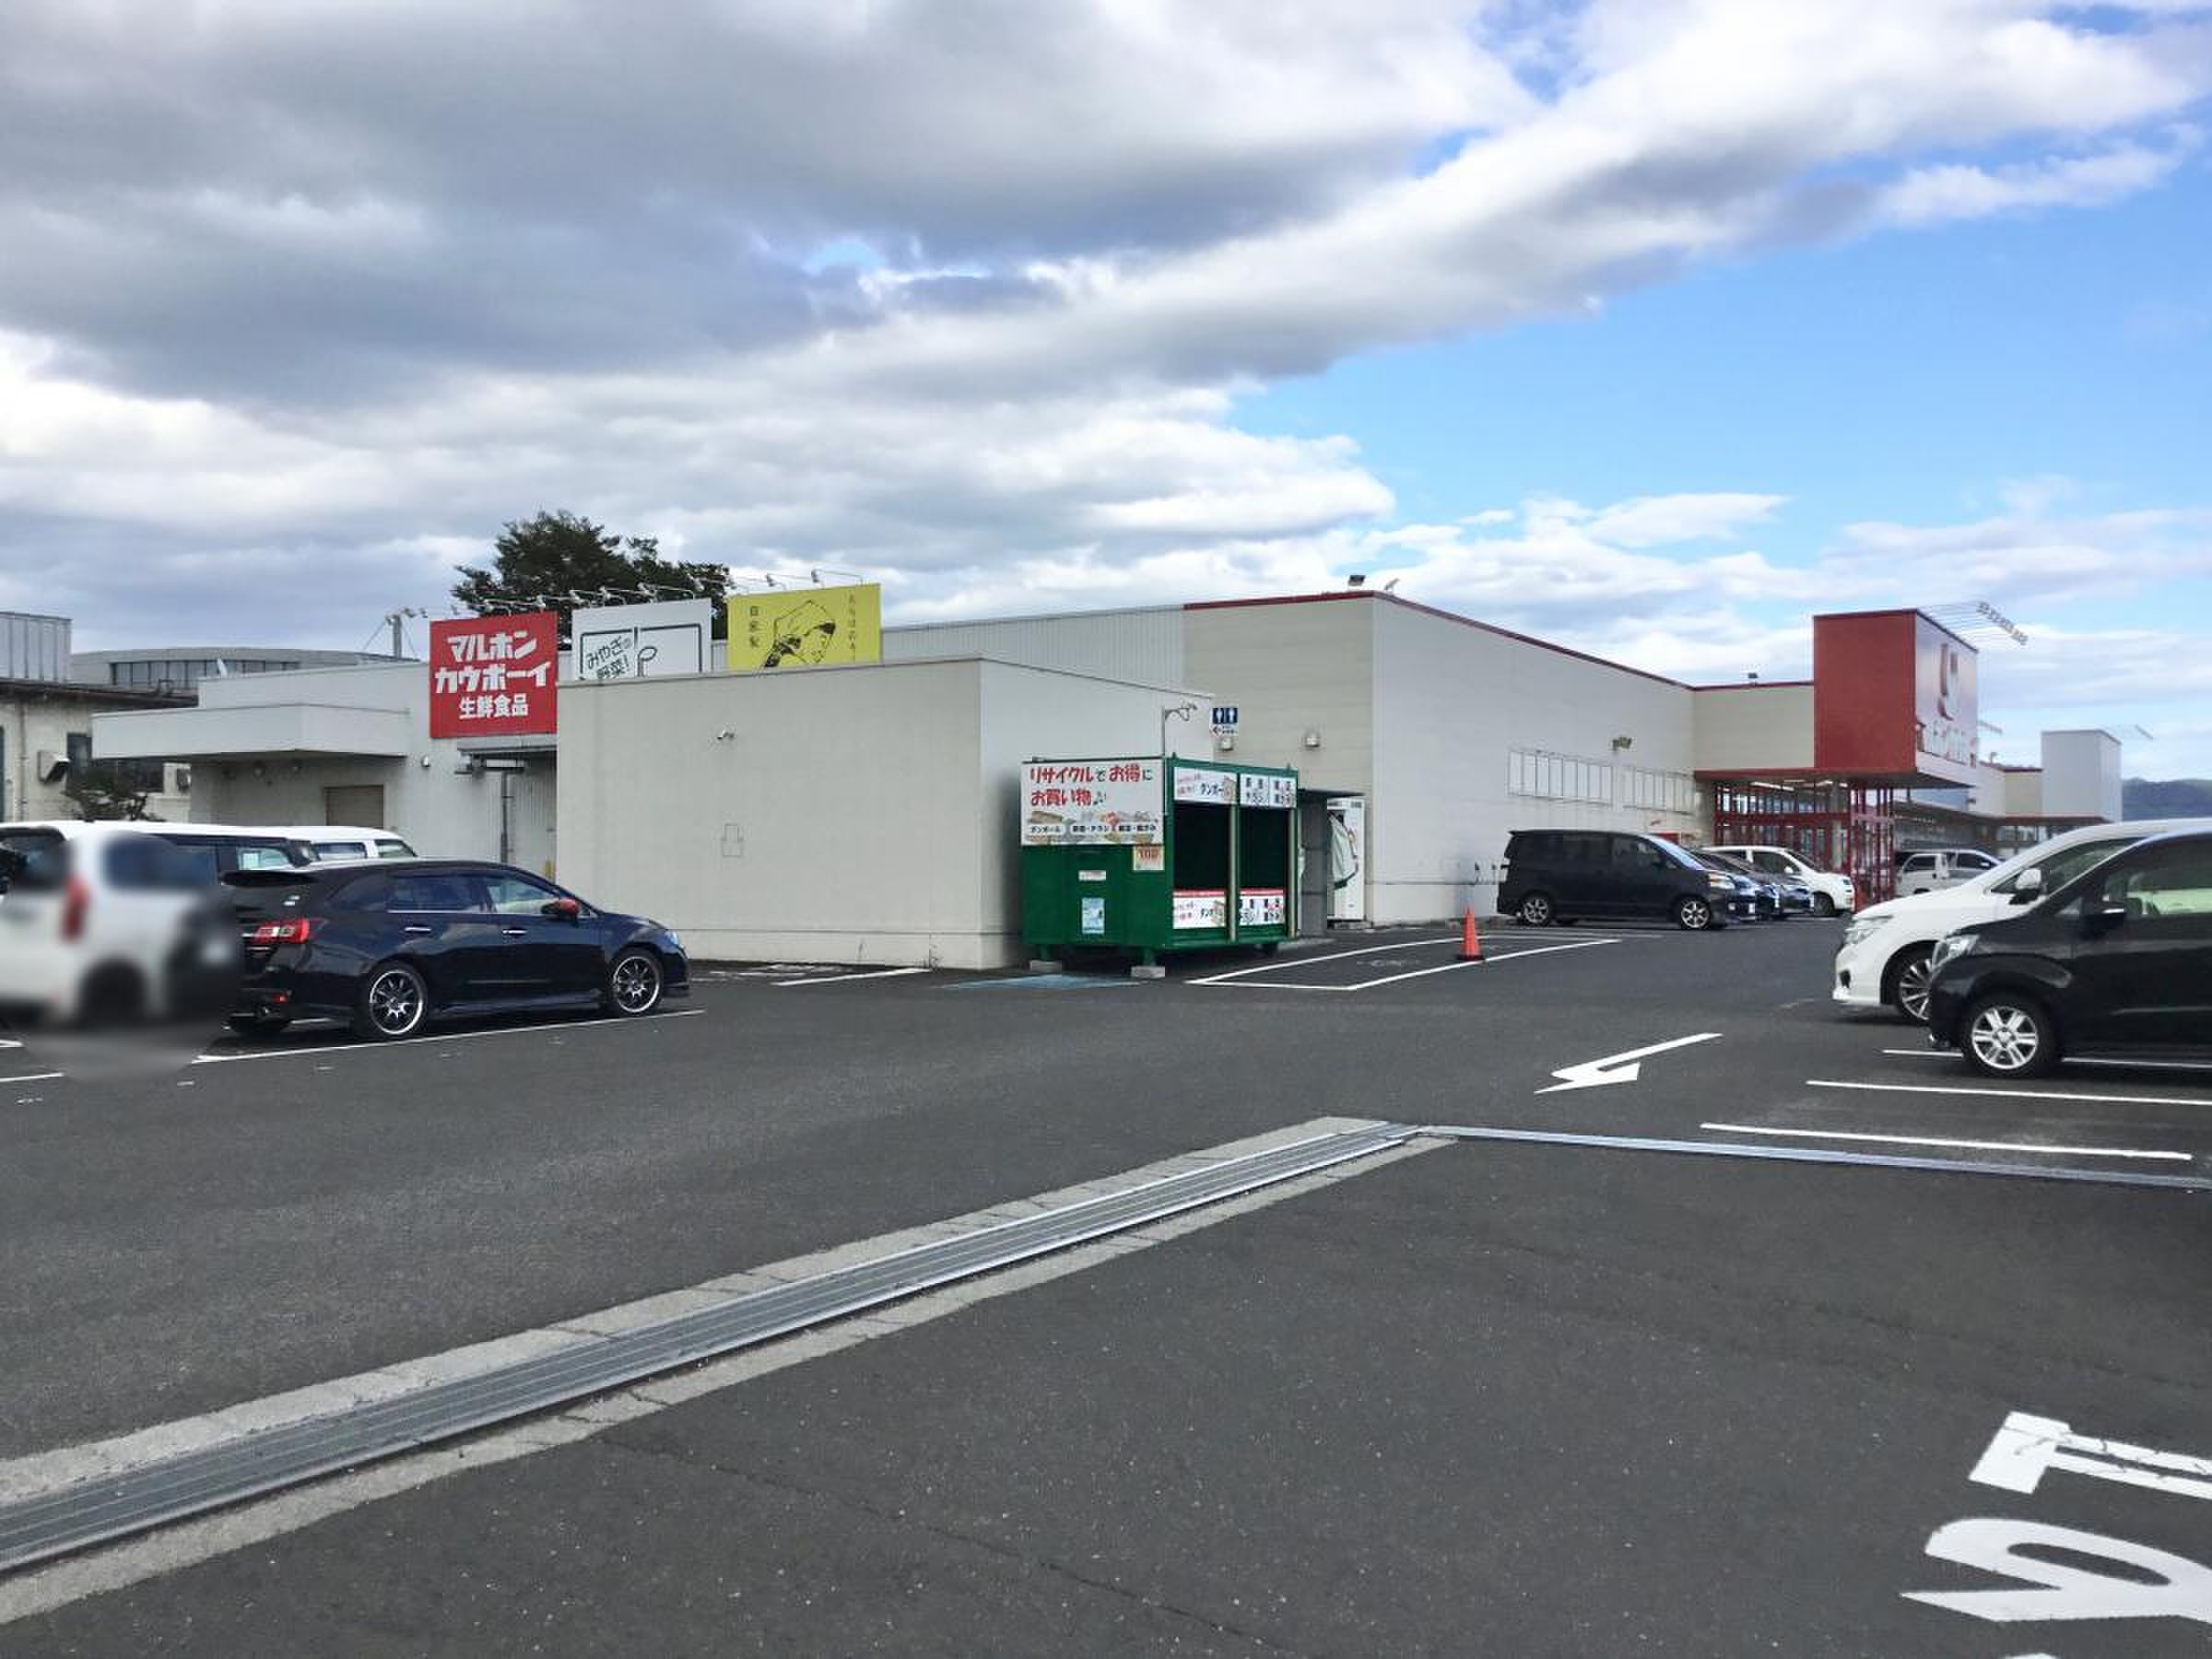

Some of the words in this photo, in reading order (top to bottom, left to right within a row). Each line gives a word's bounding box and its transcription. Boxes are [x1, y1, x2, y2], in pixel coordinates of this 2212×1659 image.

[448, 630, 537, 663] マルホン
[435, 662, 551, 694] カウボーイ
[459, 693, 529, 720] 生鮮食品
[1030, 762, 1153, 783] リサイクルでお得に
